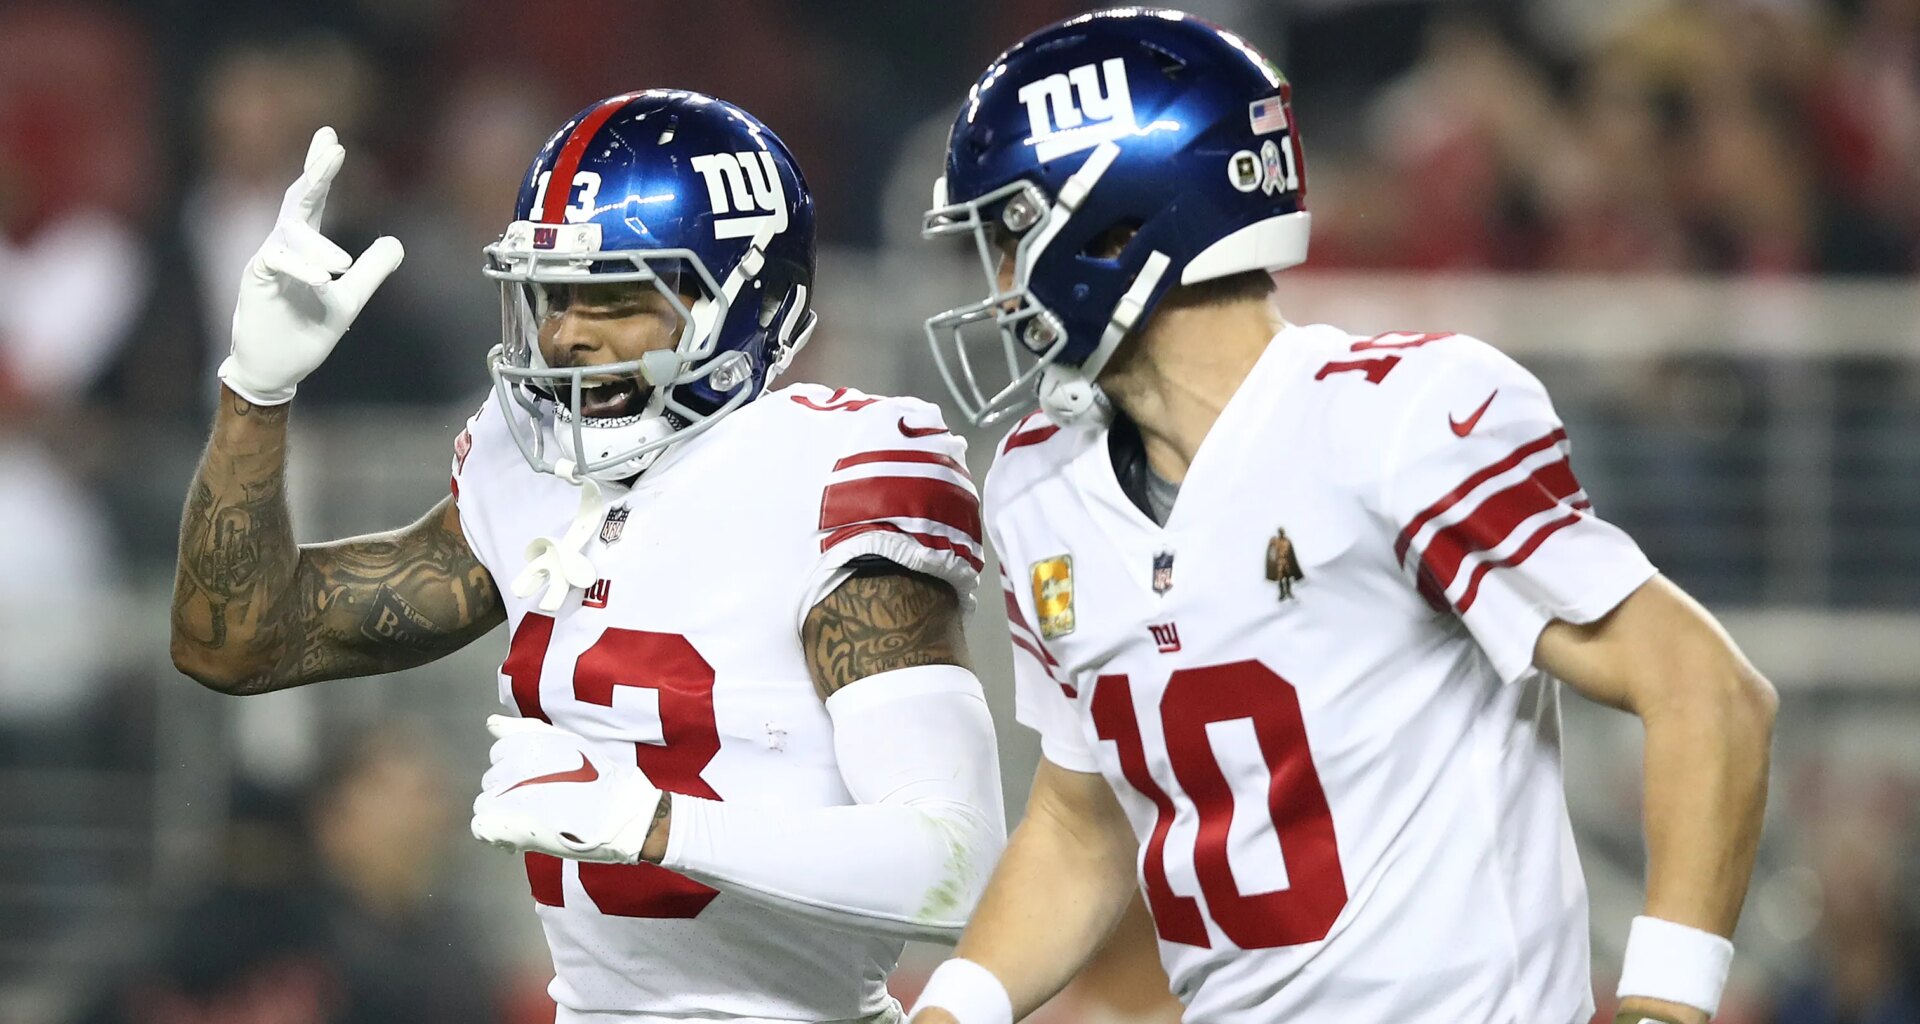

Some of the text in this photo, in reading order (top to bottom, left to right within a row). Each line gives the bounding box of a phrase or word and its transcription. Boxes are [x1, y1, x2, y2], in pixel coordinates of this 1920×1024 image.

[1018, 57, 1137, 164] ny
[528, 170, 602, 224] 13
[690, 150, 789, 240] ny
[1147, 622, 1182, 654] ny
[1090, 658, 1348, 950] 10
